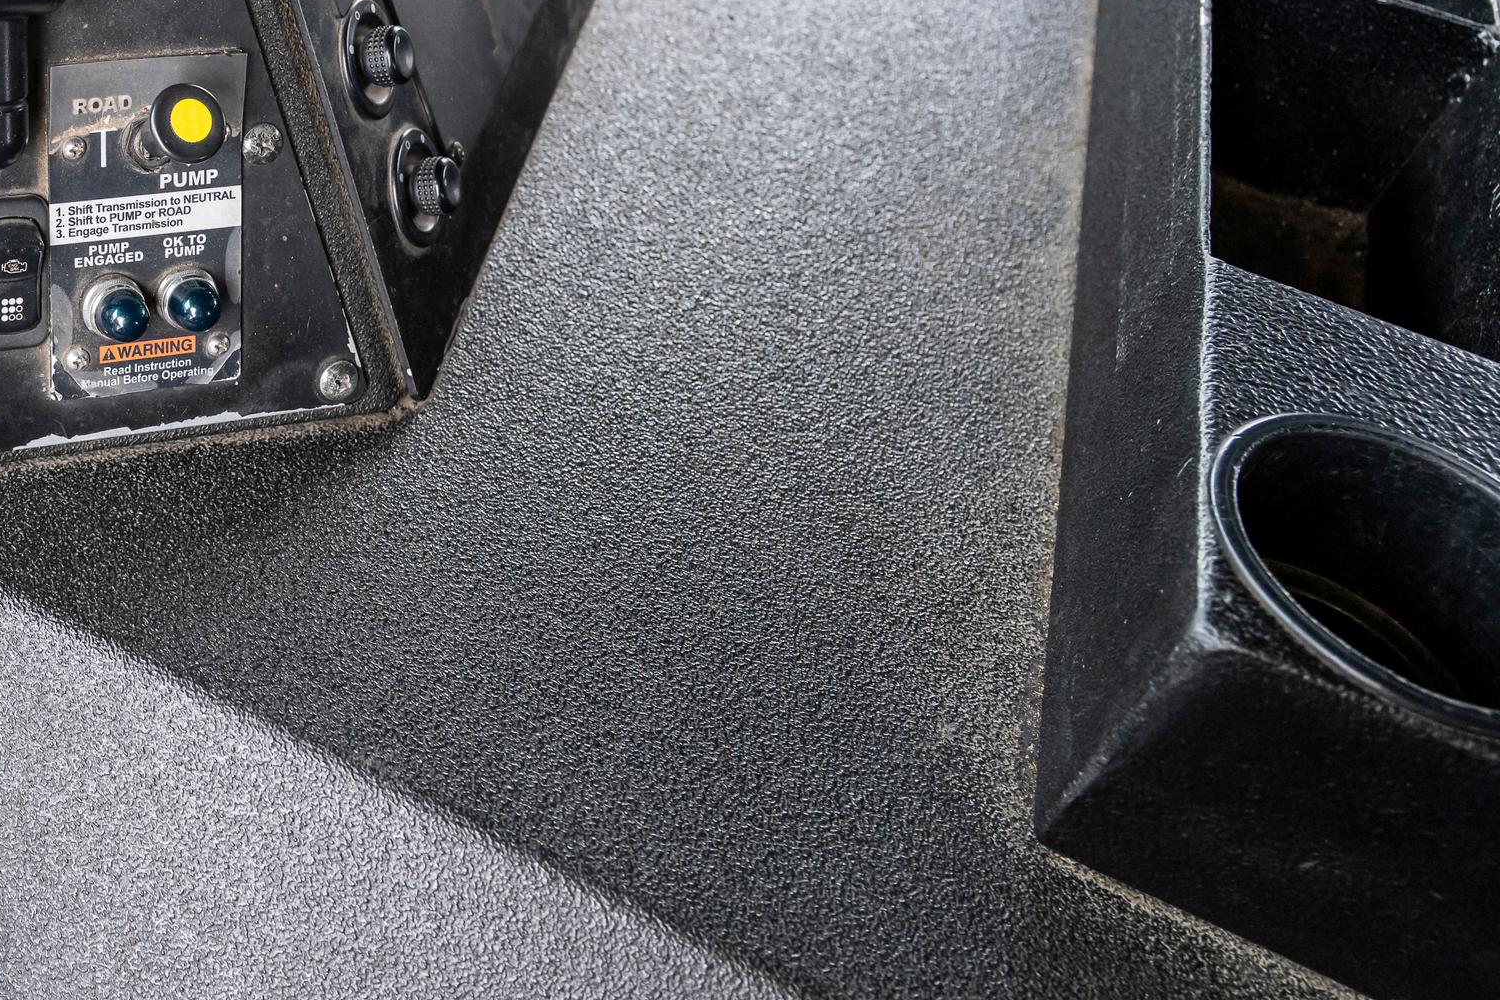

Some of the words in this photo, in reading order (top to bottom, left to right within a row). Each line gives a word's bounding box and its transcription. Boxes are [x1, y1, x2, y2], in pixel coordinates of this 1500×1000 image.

[72, 95, 132, 115] ROAD
[159, 168, 219, 189] PUMP
[56, 207, 65, 217] 1.
[68, 204, 93, 216] Shift
[96, 198, 167, 213] Transmission
[170, 196, 179, 206] to
[183, 190, 236, 205] NEUTRAL
[56, 217, 66, 228] 2.
[68, 214, 93, 226] Shift
[96, 213, 106, 224] to
[110, 209, 141, 223] PUMP
[145, 209, 156, 219] or
[158, 205, 191, 218] ROAD
[56, 229, 65, 238] 3.
[68, 224, 109, 240] Engage
[113, 217, 183, 234] Transmission
[88, 242, 129, 256] PUMP
[163, 236, 183, 249] OK
[186, 233, 206, 247] TO
[74, 251, 144, 269] ENGAGED
[164, 244, 205, 259] PUMP
[118, 339, 193, 359] WARNING
[104, 365, 130, 376] Read
[134, 358, 192, 374] Instruction
[123, 373, 158, 385] Before
[161, 366, 214, 382] Operating
